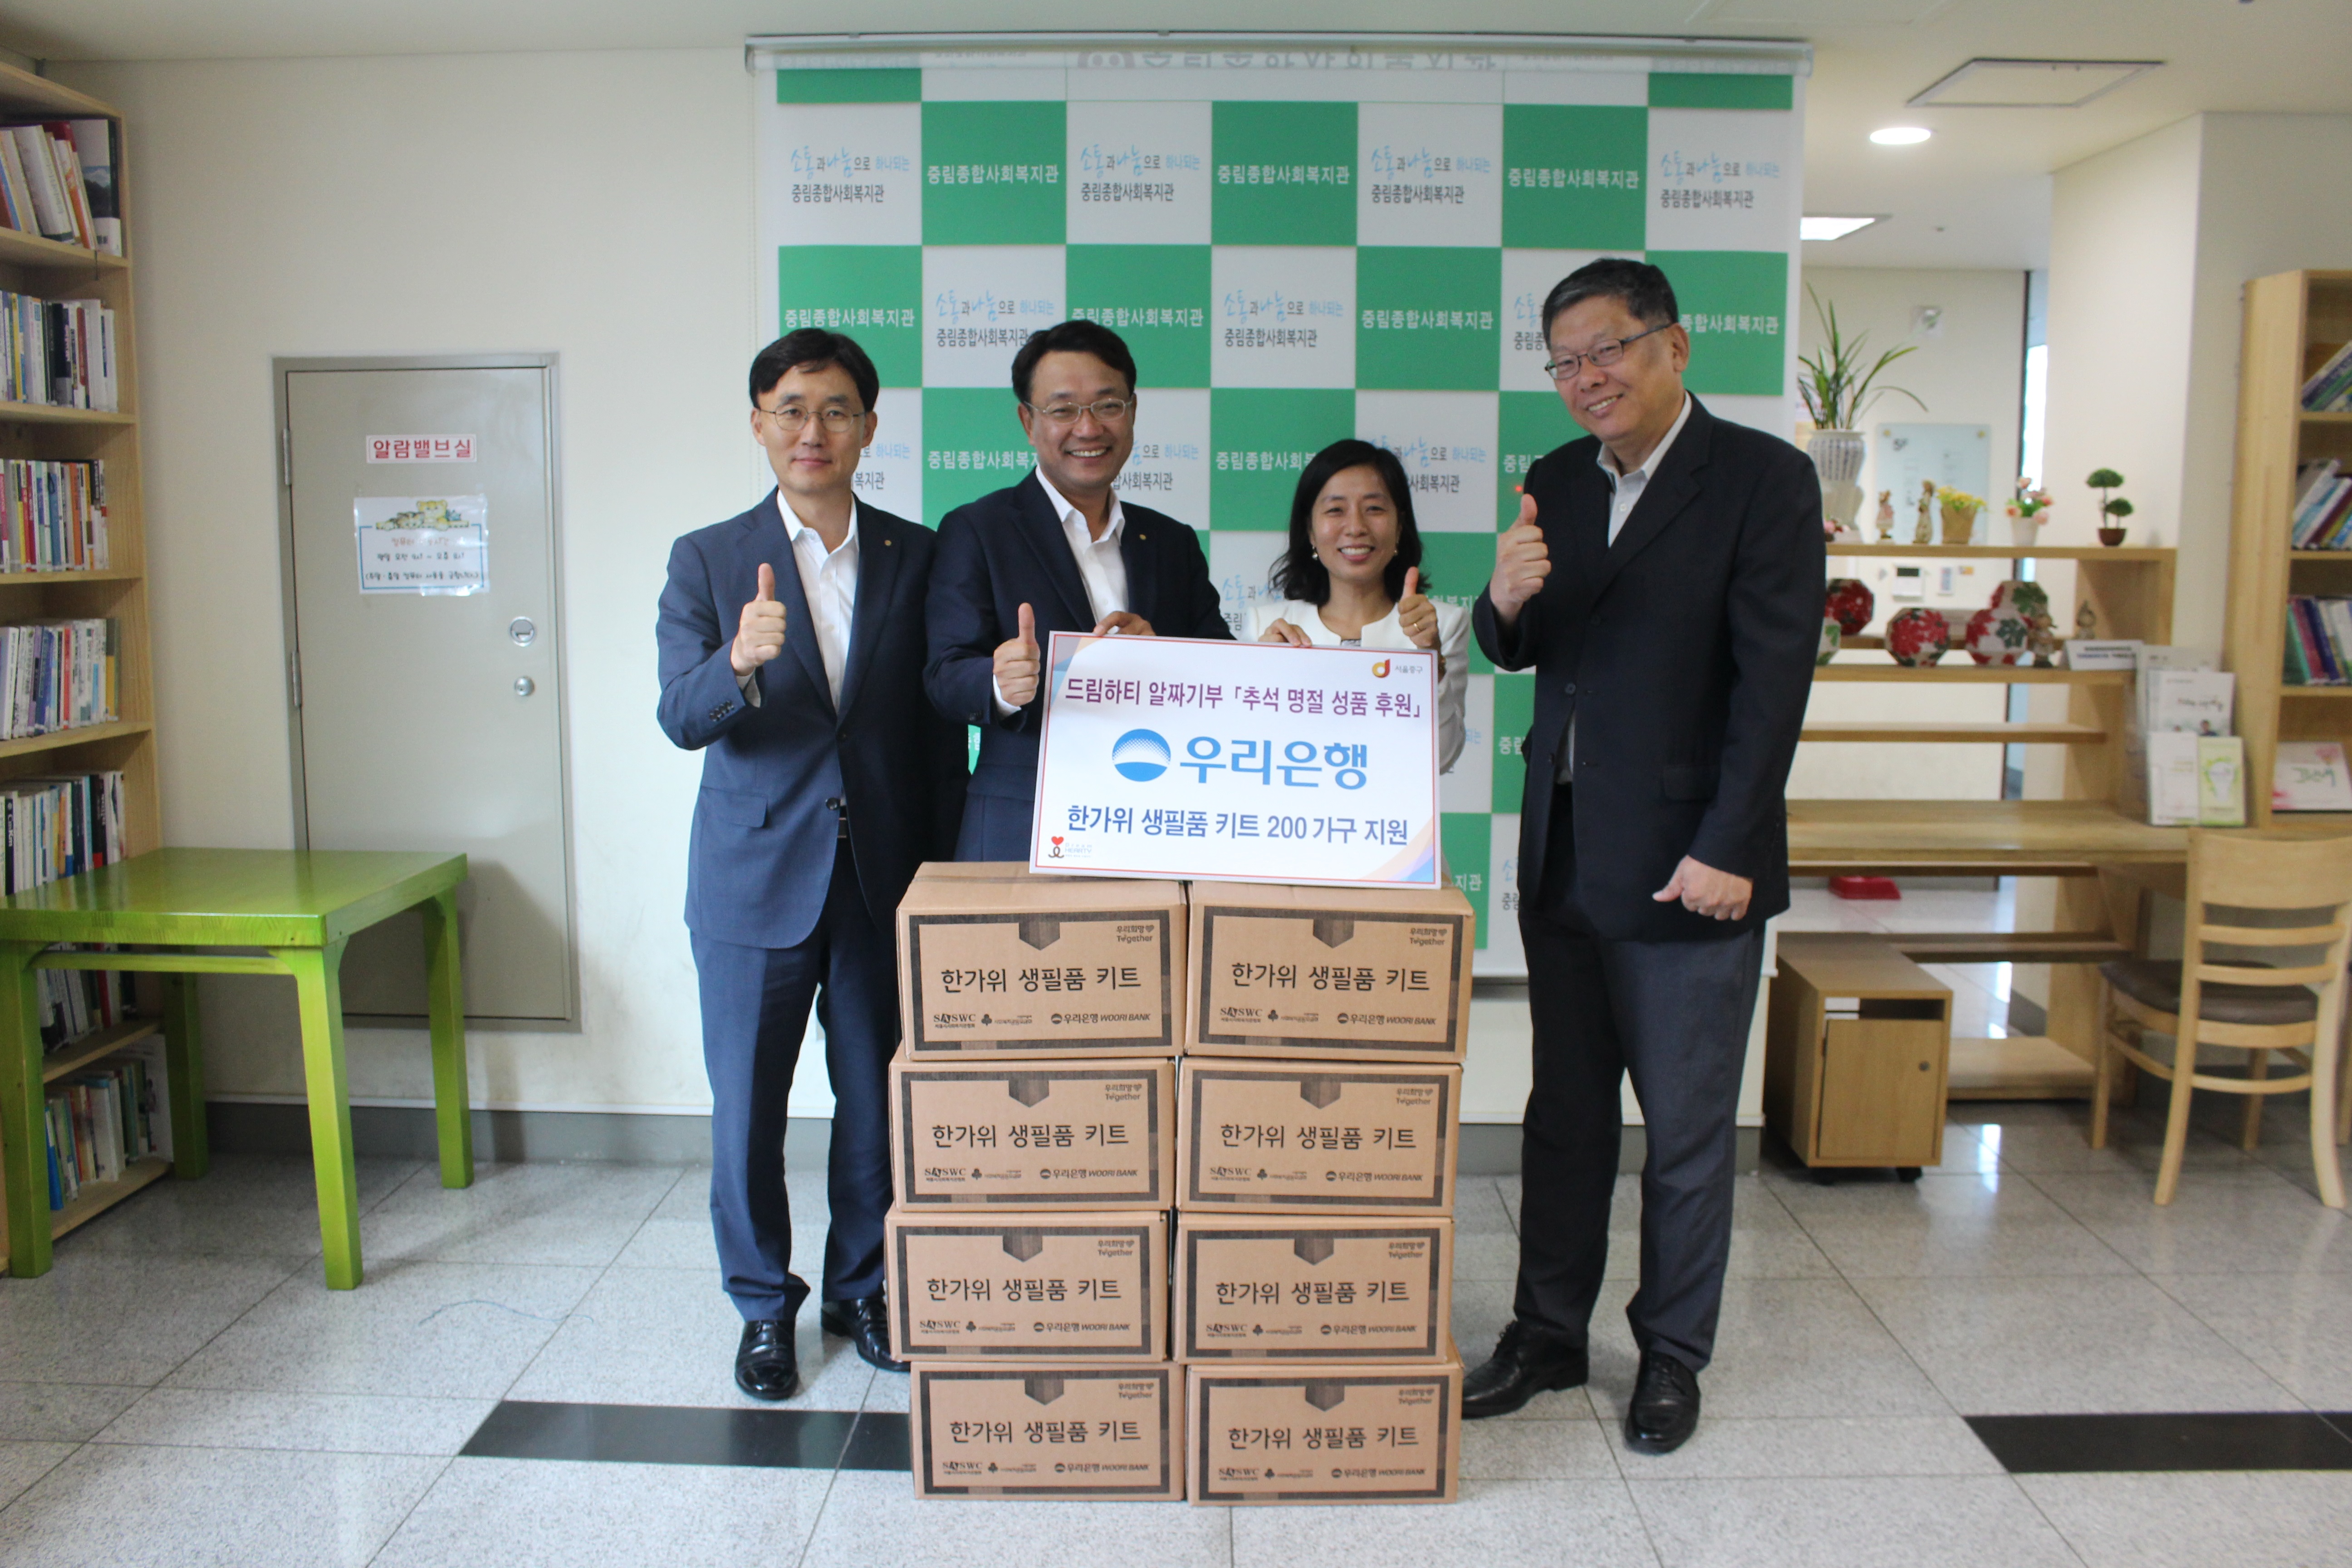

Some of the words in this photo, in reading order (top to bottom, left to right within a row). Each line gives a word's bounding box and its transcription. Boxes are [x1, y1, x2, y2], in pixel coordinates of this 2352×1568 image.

[927, 165, 1059, 185] 중림종합사회복지관
[1217, 165, 1350, 185] 중림종합사회복지관
[1508, 168, 1640, 189] 중림종합사회복지관
[792, 184, 884, 203] 중림종합사회복지관
[1081, 182, 1174, 202] 중림종합사회복지관
[1372, 184, 1465, 204] 중림종합사회복지관
[1661, 189, 1754, 209] 중림종합사회복지관
[784, 309, 915, 328] 중림종합사회복지관
[1072, 308, 1204, 327] 중림종합사회복지관
[1362, 310, 1493, 330] 중림종합사회복지관
[1680, 314, 1779, 335] 종합사회복지관
[936, 328, 1028, 347] 중림종합사회복지관
[1225, 328, 1317, 348] 중림종합사회복지관
[373, 440, 470, 459] 알람밸브실
[928, 451, 1038, 470] 중림종합사회복
[1113, 471, 1173, 490] 합사회복지관
[1409, 474, 1459, 493] 사회복지관
[1395, 666, 1423, 674] 서울중구
[1065, 679, 1140, 705] 드림하티
[1149, 682, 1223, 708] 알짜기부
[1288, 689, 1323, 714] 명절
[1332, 691, 1367, 715] 성품
[1180, 736, 1367, 789] 우리은행
[1068, 805, 1132, 834] 한가위
[1142, 809, 1208, 837] 생필품
[1216, 813, 1259, 838] 키트
[1365, 819, 1407, 845] 지원
[941, 969, 1006, 993] 한가위
[1019, 968, 1086, 992] 생필품
[1097, 966, 1141, 990] 키트
[1232, 963, 1296, 989] 한가위
[1309, 966, 1376, 991] 생필품
[1387, 968, 1430, 992] 키트
[1063, 1014, 1098, 1024] 우리은행
[1350, 1014, 1384, 1025] 우리은행
[932, 1125, 996, 1148] 한가위
[1009, 1124, 1074, 1148] 생필품
[1086, 1124, 1128, 1147] 키트
[1221, 1124, 1284, 1148] 한가위
[1297, 1127, 1362, 1150] 생필품
[1374, 1127, 1416, 1150] 키트
[1053, 1169, 1087, 1178] 우리은행
[927, 1279, 990, 1301] 한가위
[1003, 1279, 1067, 1302] 생필품
[1079, 1279, 1121, 1301] 키트
[1216, 1282, 1279, 1305] 한가위
[1292, 1282, 1357, 1305] 생필품
[1367, 1281, 1409, 1303] 키트
[950, 1421, 1012, 1444] 한가위
[1024, 1421, 1088, 1444] 생필품
[1099, 1421, 1141, 1442] 키트
[1229, 1428, 1290, 1450] 한가위
[1303, 1427, 1367, 1450] 생필품
[1377, 1426, 1419, 1447] 키트
